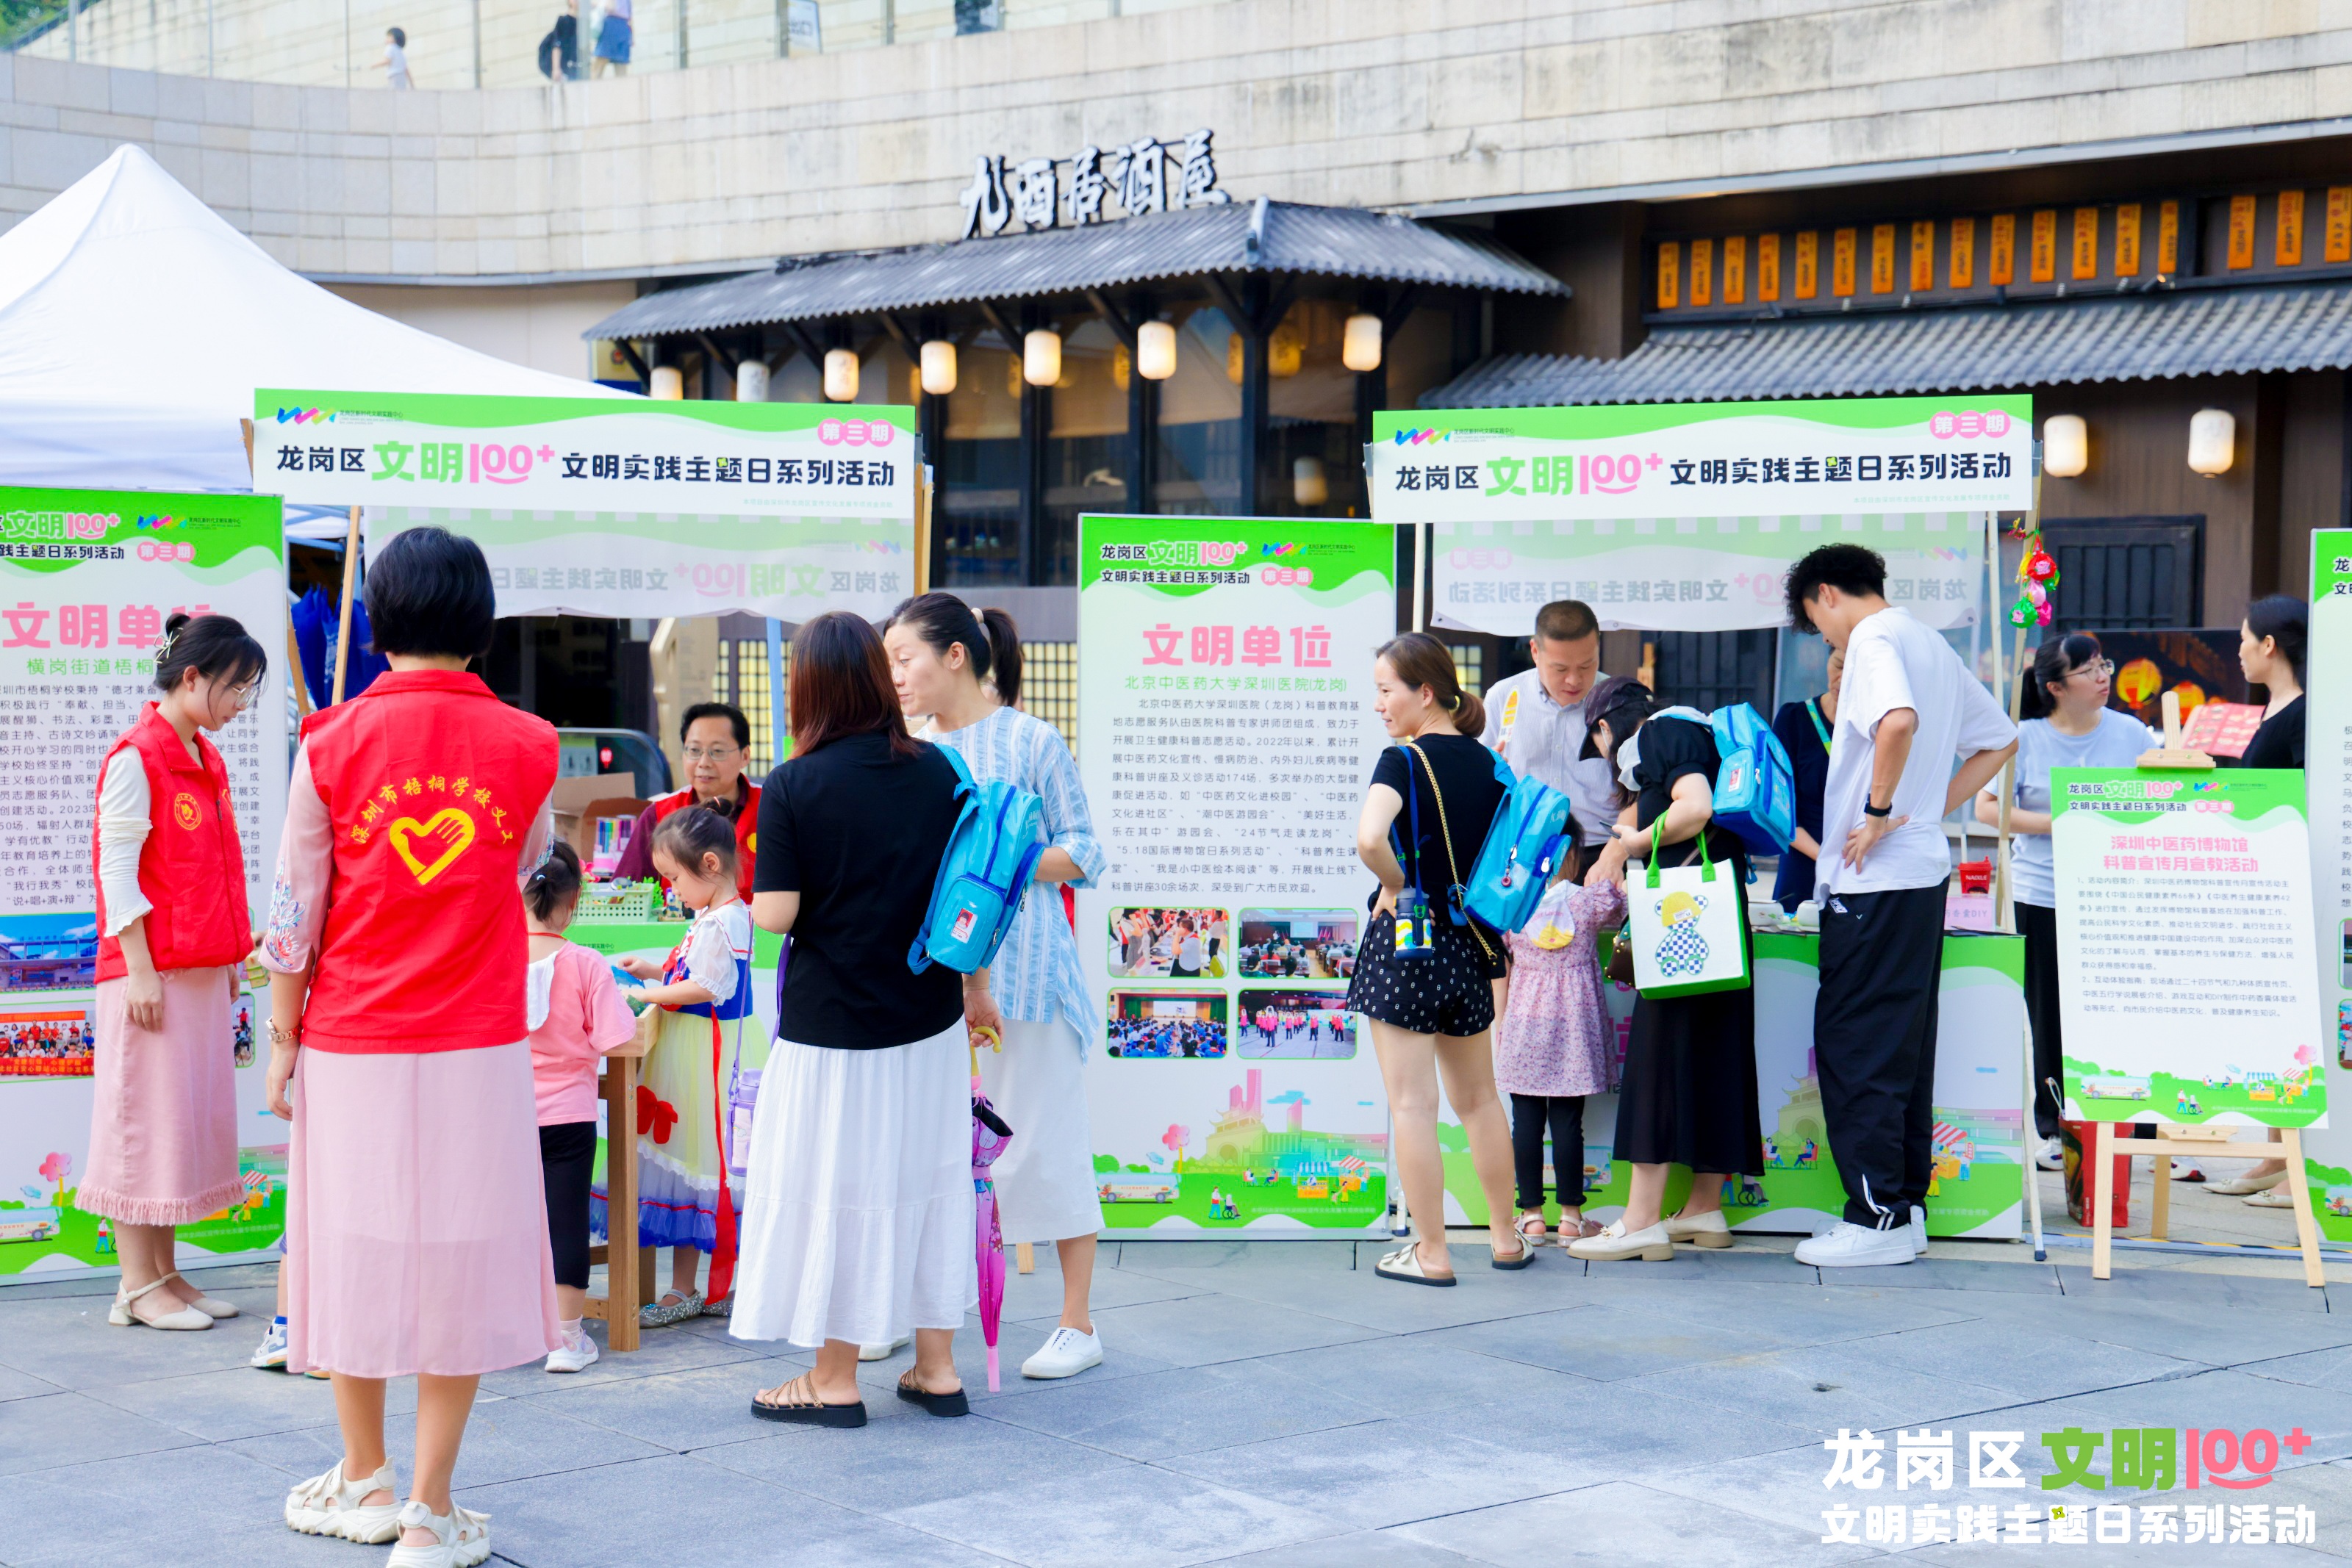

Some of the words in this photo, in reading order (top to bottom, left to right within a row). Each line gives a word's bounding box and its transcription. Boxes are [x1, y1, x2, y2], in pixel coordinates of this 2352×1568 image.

[1935, 414, 2007, 434] 第三期
[822, 422, 891, 442] 第三期
[0, 511, 120, 539] 文明100+
[140, 544, 192, 559] 第三期
[2335, 558, 2352, 572] 龙
[1101, 570, 1250, 585] 文明实践主题日系列活动
[1263, 569, 1311, 583] 第三期
[1142, 623, 1332, 668] 文明单位
[26, 658, 154, 675] 横岗街道梧桐
[0, 685, 157, 696] 圳市梧桐学校秉持“德才兼备
[1125, 675, 1347, 692] 北京中医药大学深圳医院(龙岗)
[0, 744, 112, 755] 校开心学习的同时也
[0, 774, 97, 785] 主义核心价值观和
[2069, 801, 2187, 812] 文明实践主题日系列活动
[2196, 801, 2234, 813] 第三期
[5, 835, 93, 846] 学有优教”行动
[2111, 835, 2248, 852] 深圳中医药博物馆
[0, 866, 93, 876] 合作，全体师生
[2104, 855, 2259, 872] 科普宣传月宣教活动
